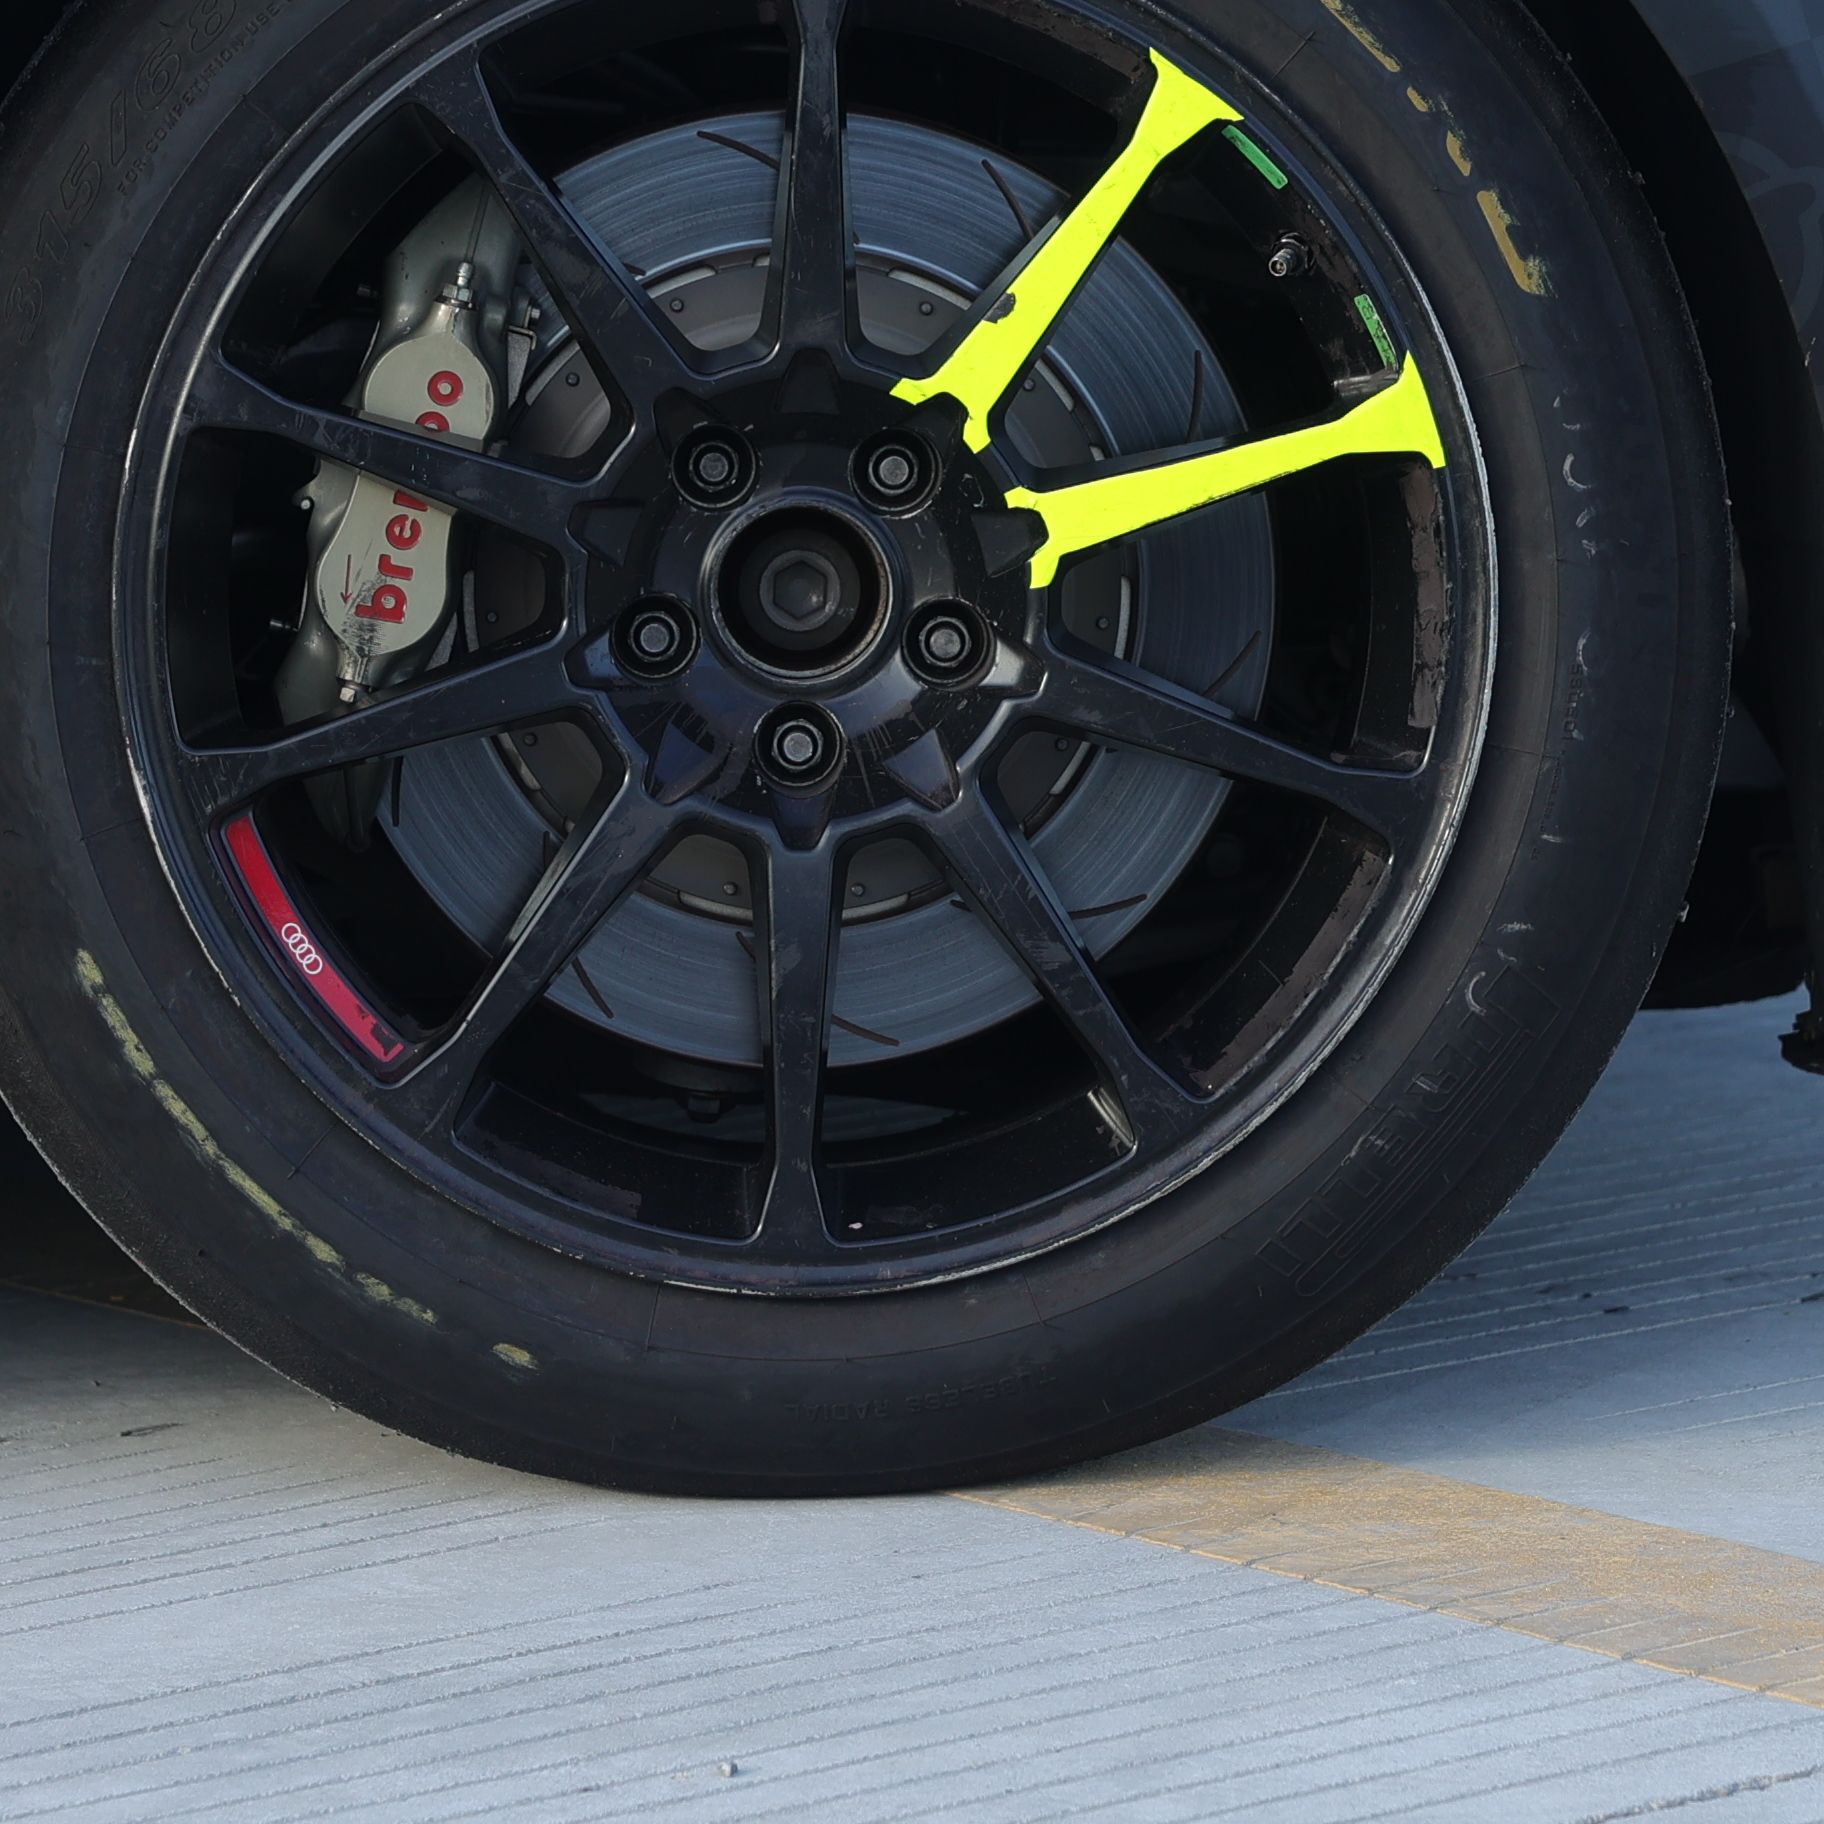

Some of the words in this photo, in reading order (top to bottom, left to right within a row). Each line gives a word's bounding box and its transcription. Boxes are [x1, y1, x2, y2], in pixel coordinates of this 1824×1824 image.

[116, 155, 149, 195] FOR
[143, 34, 246, 155] COMPETITION
[241, 0, 283, 37] USE
